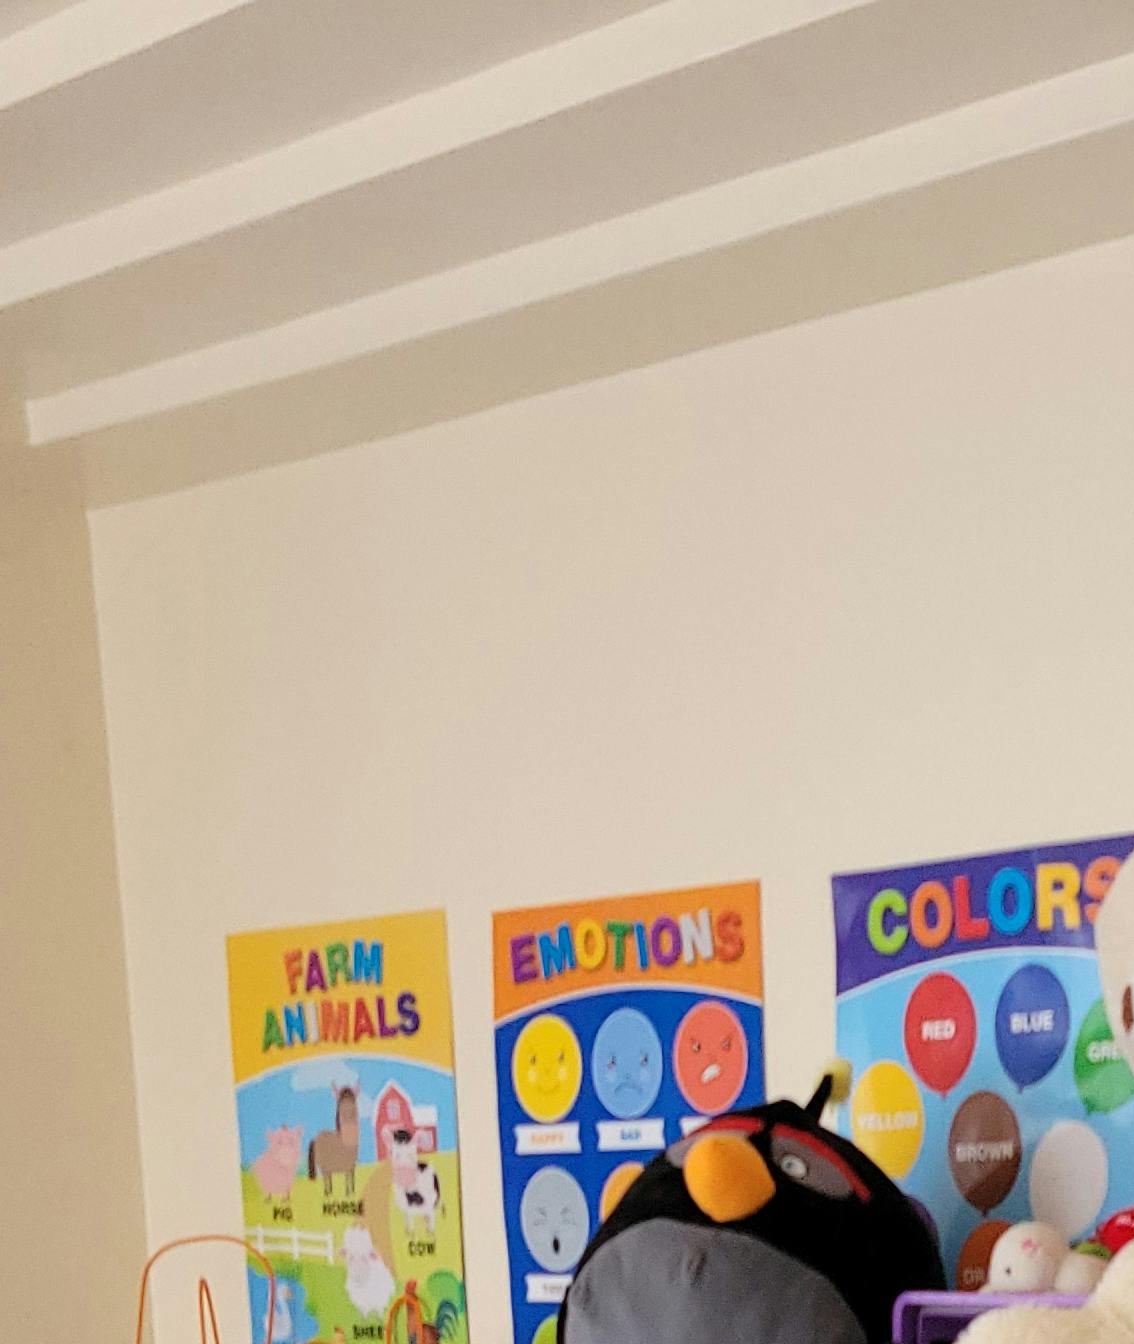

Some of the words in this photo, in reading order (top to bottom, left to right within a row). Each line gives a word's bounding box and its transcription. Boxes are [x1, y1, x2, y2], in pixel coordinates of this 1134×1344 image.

[867, 856, 1123, 954] COLORS
[510, 908, 745, 984] EMOTIONS
[283, 940, 384, 996] FARM
[262, 993, 421, 1052] ANIMALS
[922, 1019, 956, 1041] RED
[1010, 1009, 1054, 1034] BLUE
[1087, 1041, 1121, 1062] GRE
[857, 1111, 918, 1133] YELLOW
[955, 1141, 1015, 1164] BROWN
[273, 1206, 293, 1220] PIG
[323, 1200, 365, 1217] HORSE
[408, 1241, 435, 1256] COW
